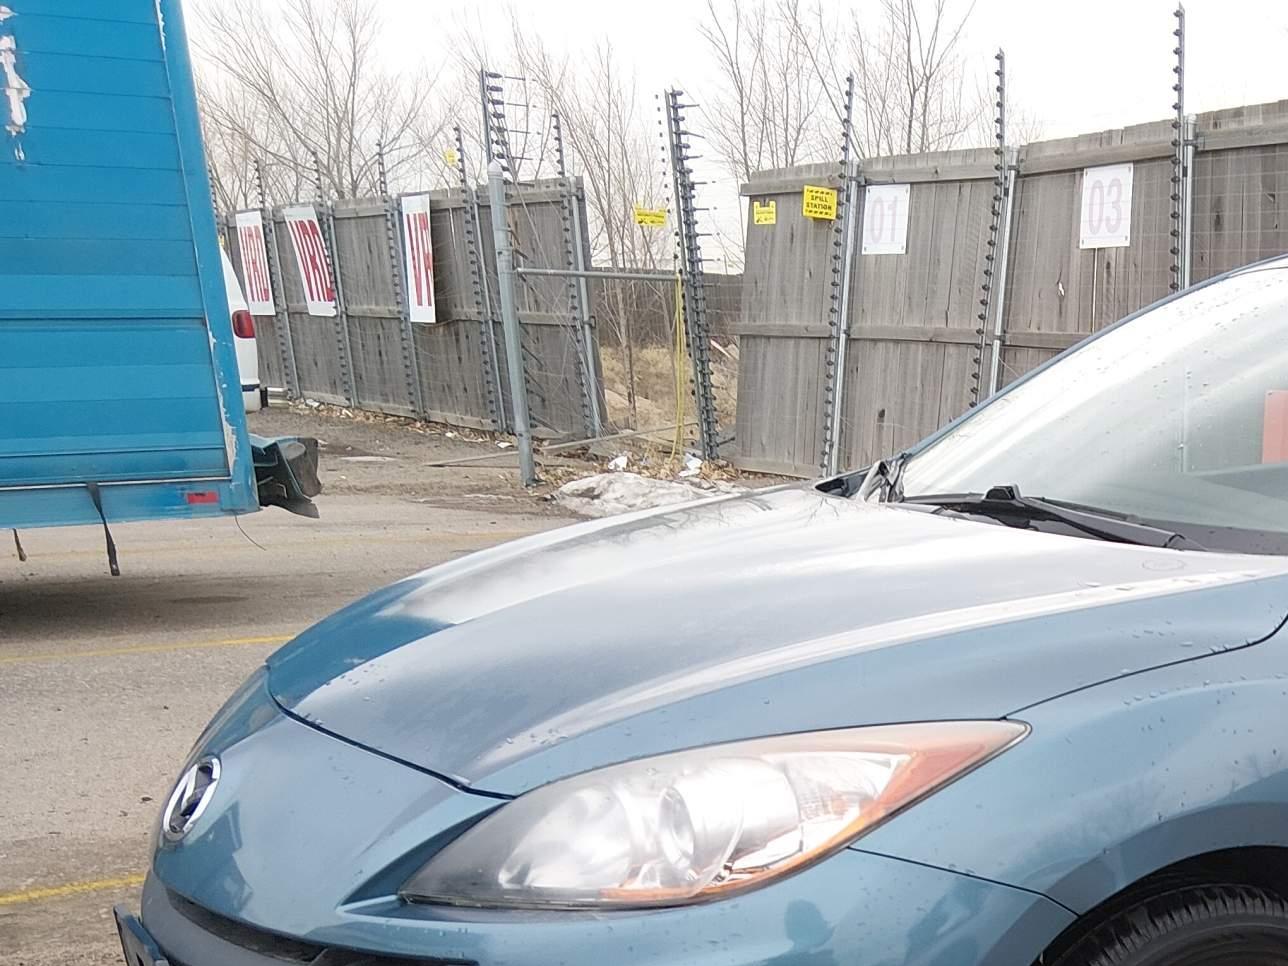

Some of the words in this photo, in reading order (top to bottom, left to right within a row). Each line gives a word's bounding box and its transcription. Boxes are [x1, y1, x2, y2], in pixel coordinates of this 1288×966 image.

[806, 202, 832, 211] STATION
[810, 195, 829, 204] SPILL
[1088, 178, 1122, 235] 03
[870, 196, 898, 245] 01
